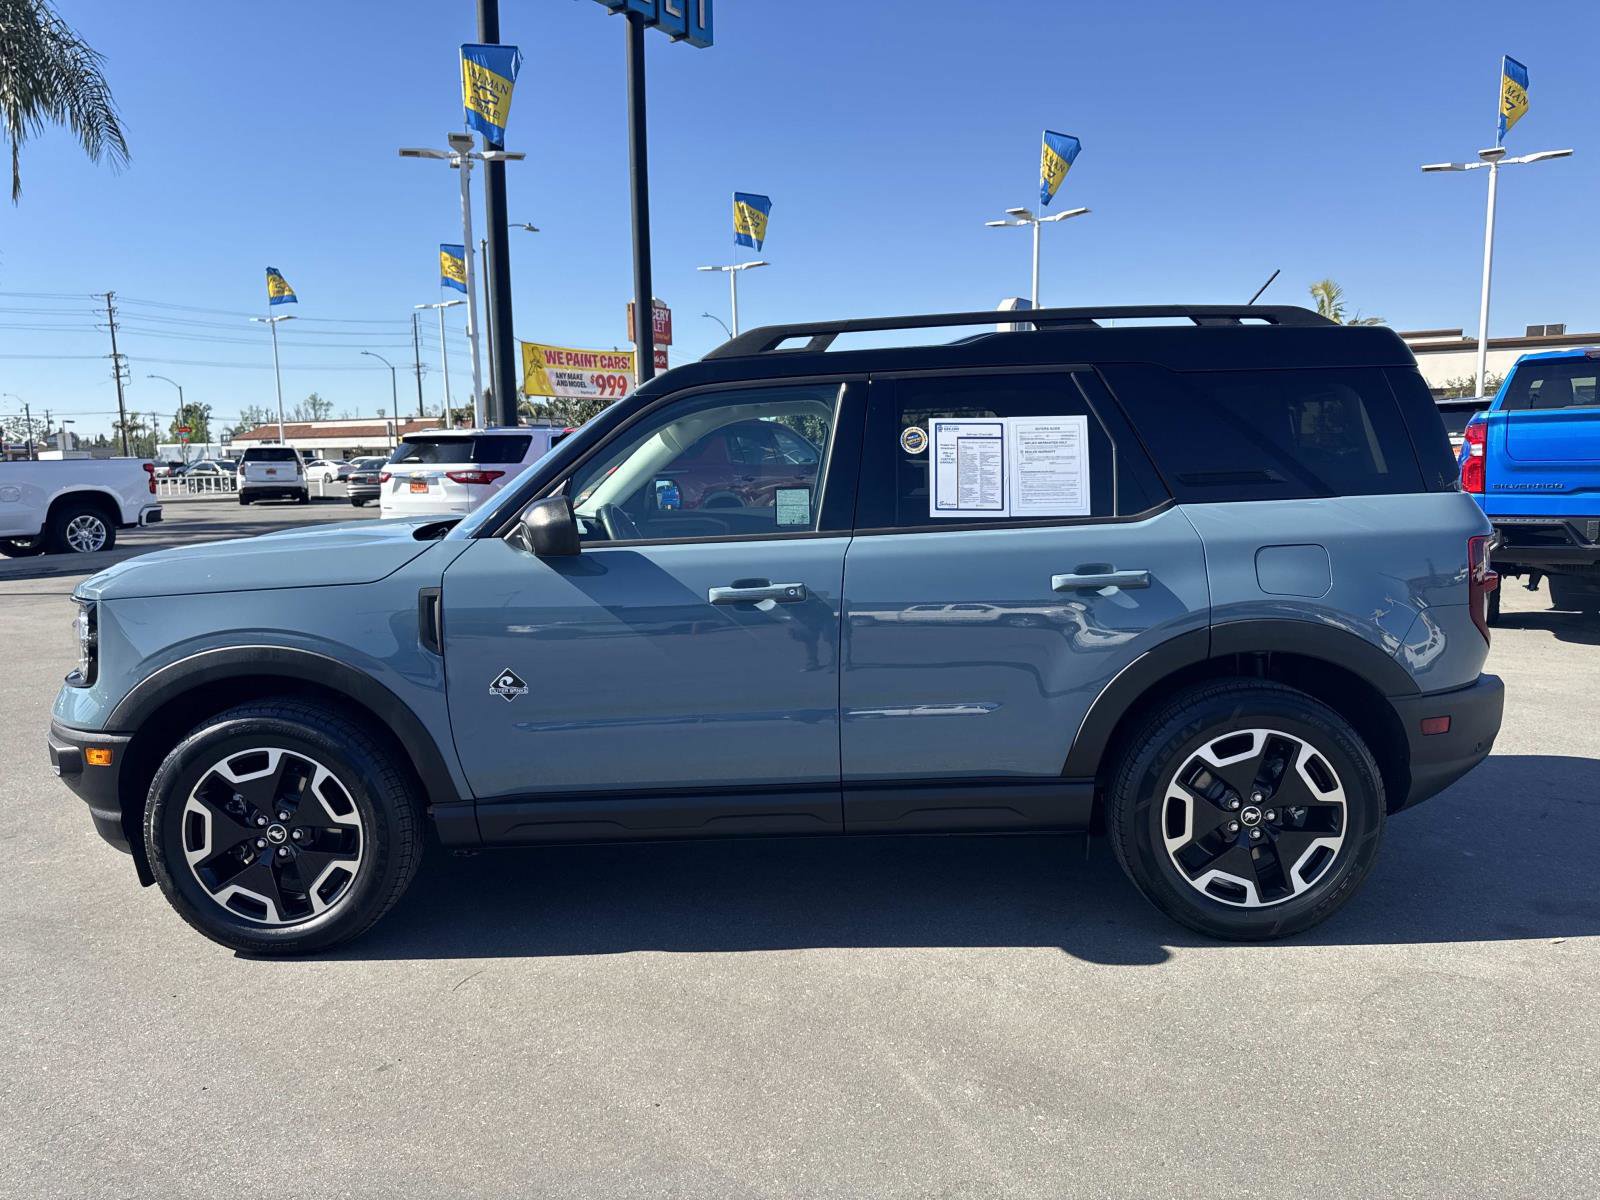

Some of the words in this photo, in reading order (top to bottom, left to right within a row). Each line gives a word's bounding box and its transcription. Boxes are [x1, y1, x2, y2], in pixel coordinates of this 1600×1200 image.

[544, 350, 564, 365] WE
[566, 352, 598, 369] PAINT
[600, 355, 631, 370] CARS!
[556, 372, 566, 380] ANY
[567, 373, 583, 381] MAKE
[569, 381, 587, 389] MODEL
[591, 373, 627, 396] $999
